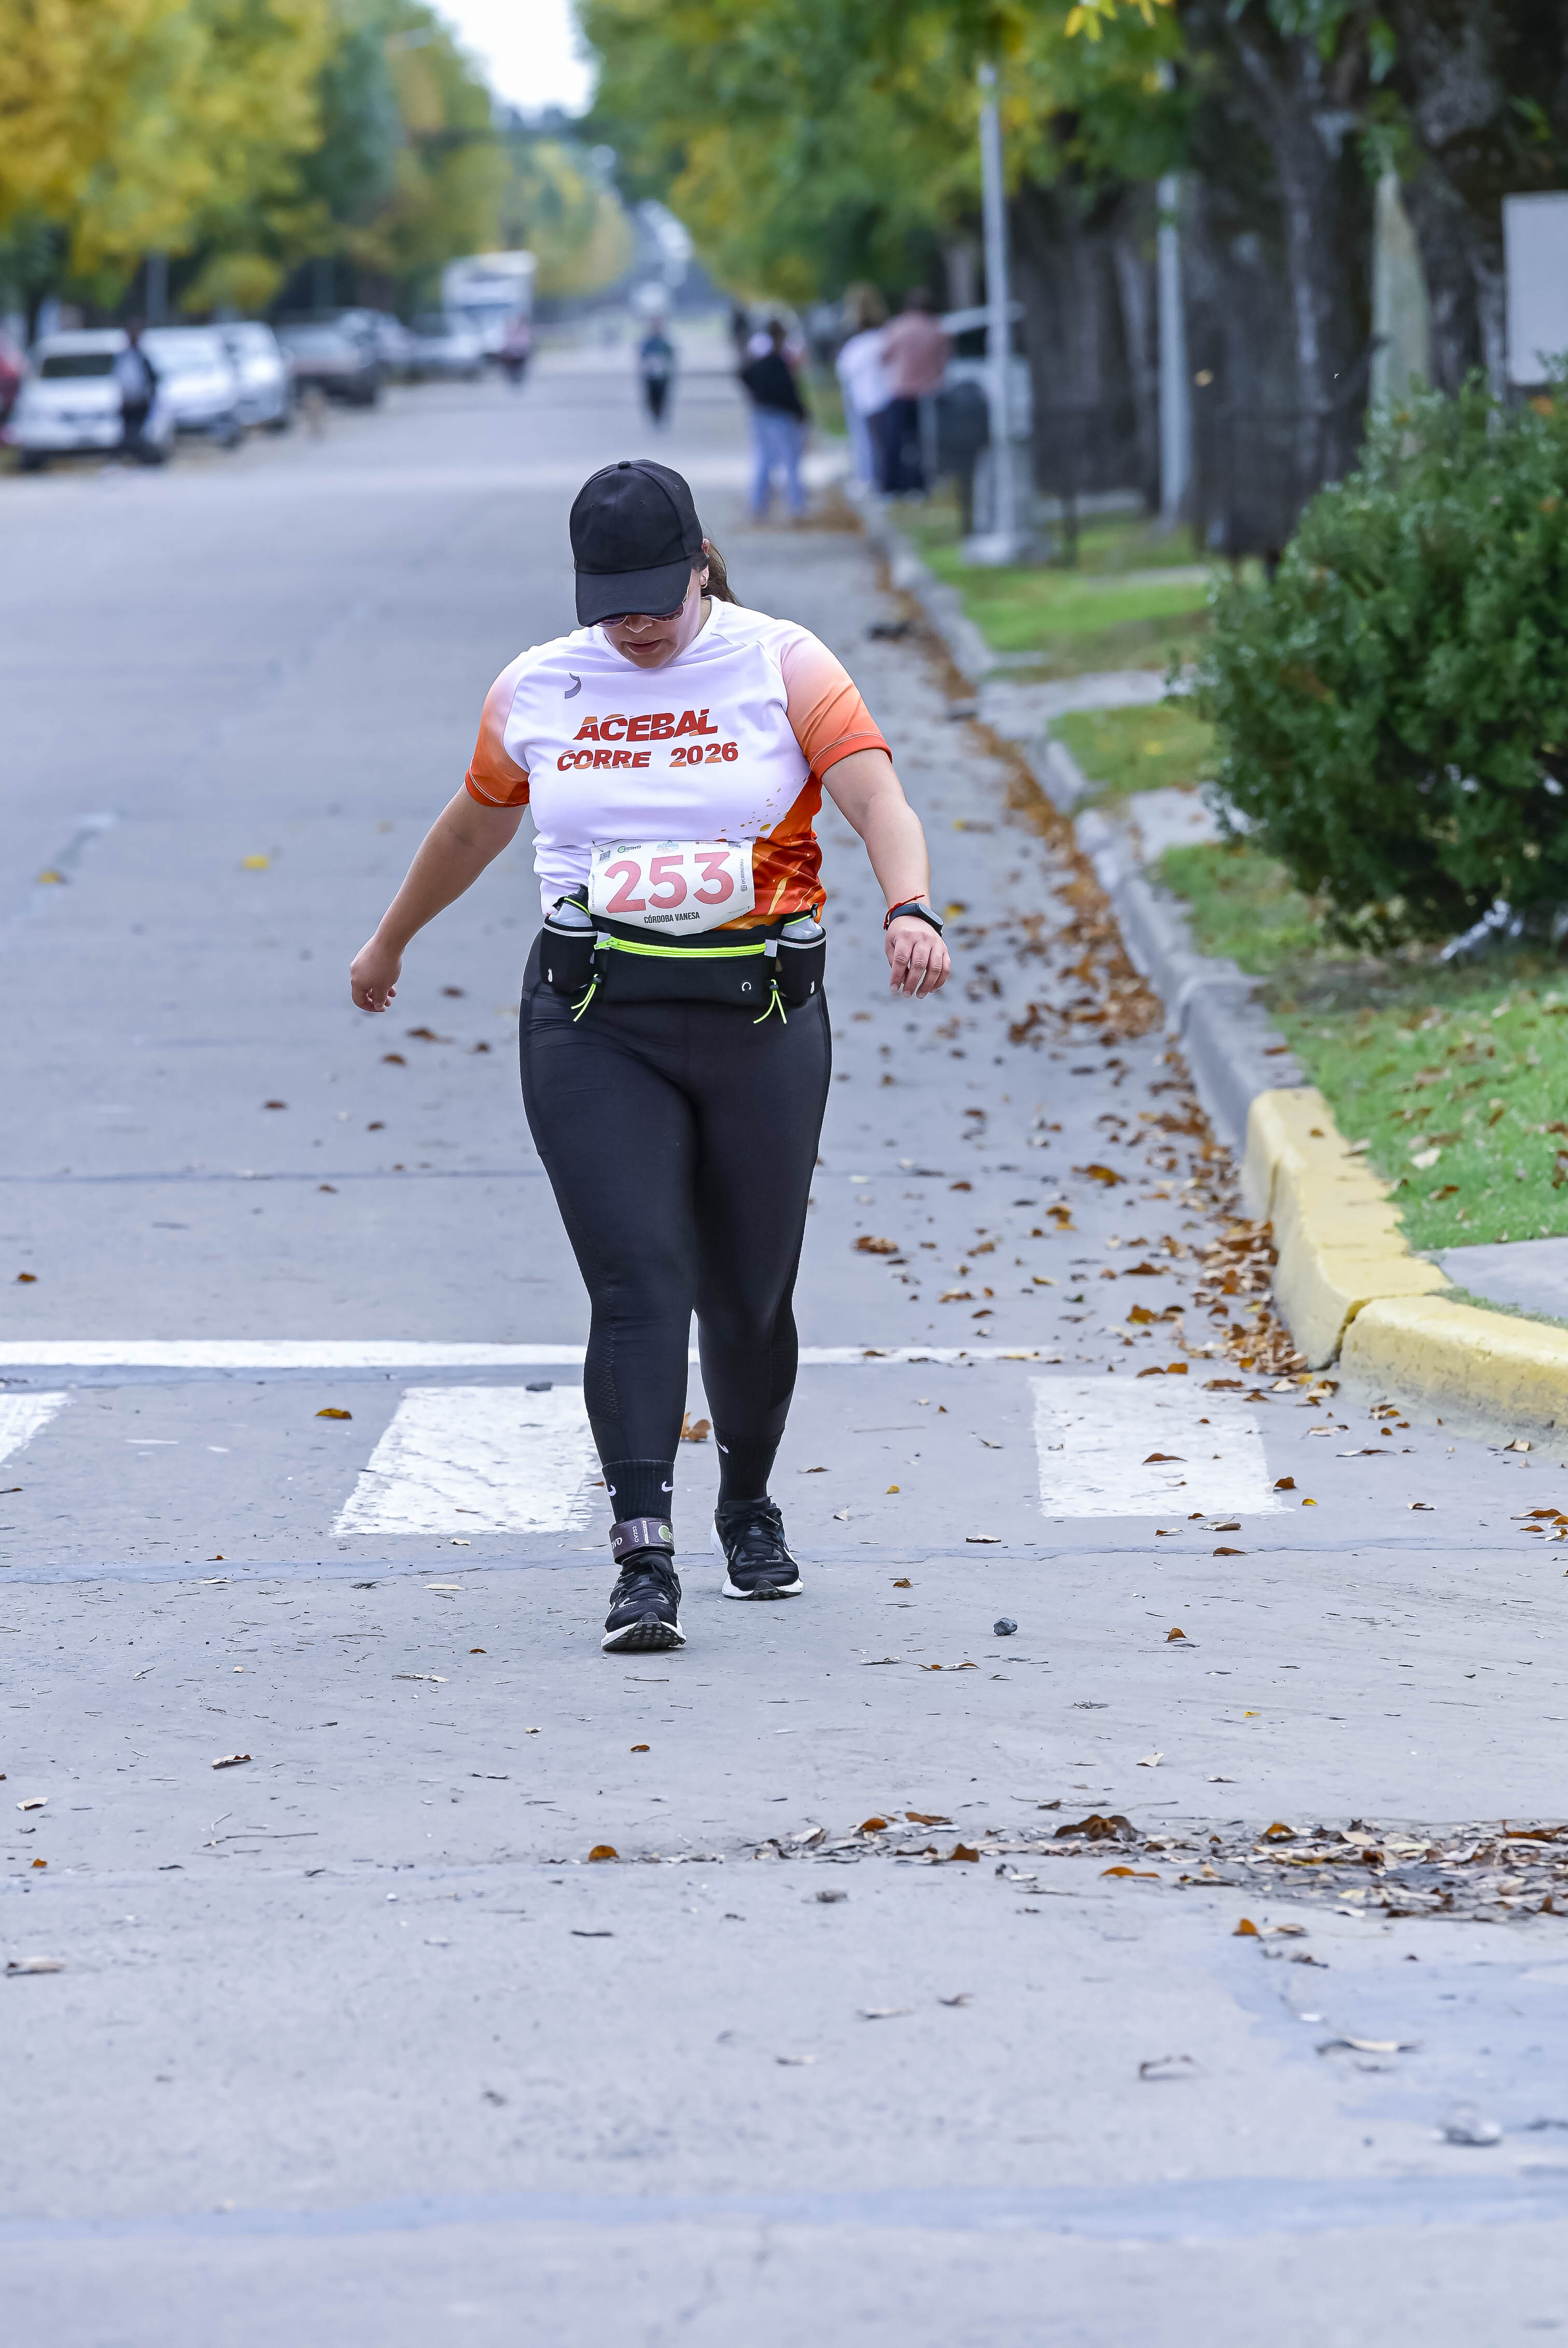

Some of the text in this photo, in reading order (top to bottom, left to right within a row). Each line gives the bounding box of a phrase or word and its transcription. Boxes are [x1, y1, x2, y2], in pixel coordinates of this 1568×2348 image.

[572, 708, 718, 742] ACEBAL
[557, 742, 738, 772] CORRE 2026
[604, 851, 734, 914] 253
[643, 911, 701, 924] CÓRDOBA VANESA
